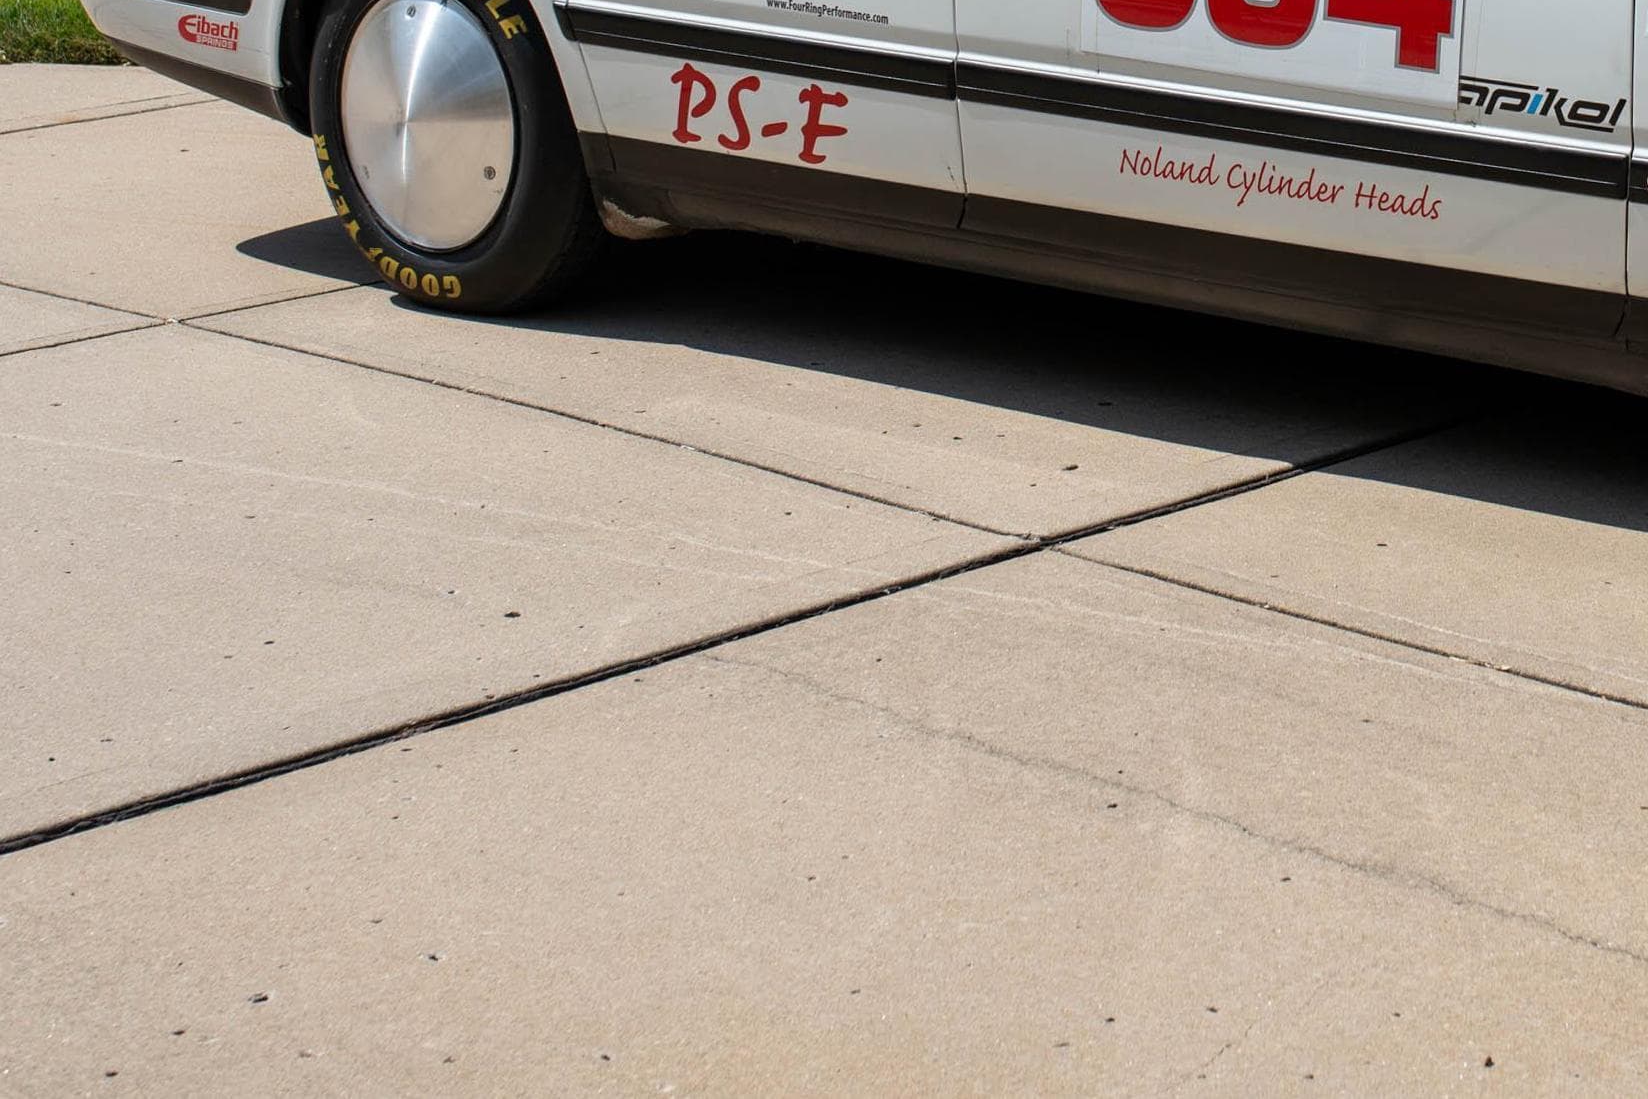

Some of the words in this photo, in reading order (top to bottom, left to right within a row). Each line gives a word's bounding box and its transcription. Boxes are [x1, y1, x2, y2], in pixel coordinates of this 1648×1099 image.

[178, 14, 238, 42] Eibach
[1119, 146, 1220, 186] Noland
[1226, 161, 1344, 207] Cylinder
[1354, 181, 1443, 220] Heads
